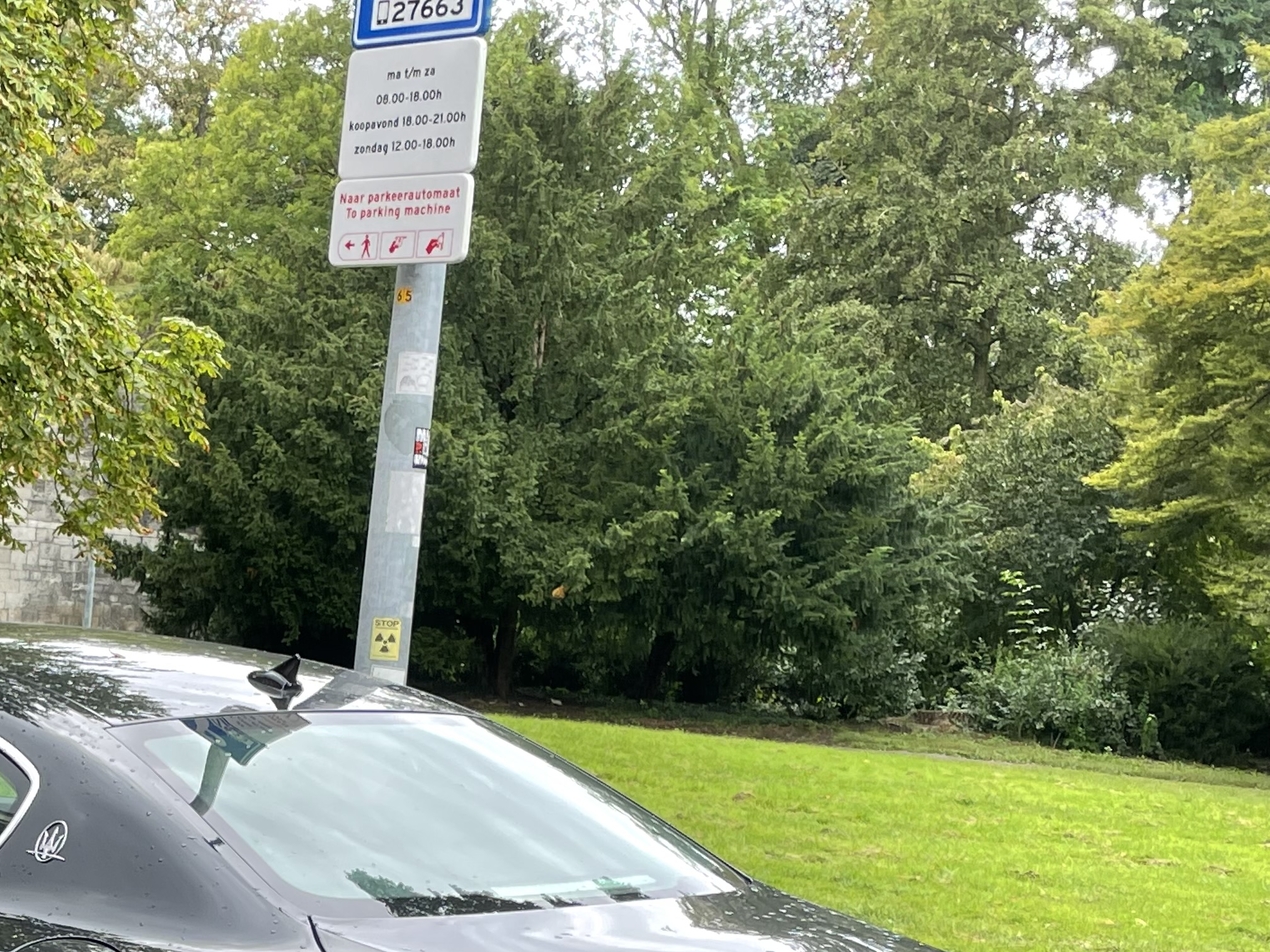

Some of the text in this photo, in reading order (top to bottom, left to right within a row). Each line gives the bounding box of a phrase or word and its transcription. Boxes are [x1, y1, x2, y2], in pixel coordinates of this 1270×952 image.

[391, 0, 463, 23] 27663
[387, 67, 436, 80] ma t/m za
[376, 89, 442, 105] 08.00-18.00h
[349, 111, 467, 132] koopavond 18.00-21.00h
[354, 137, 456, 155] zondag 12.00-18.00h
[339, 186, 461, 205] Naar parkeerautomaat
[346, 203, 451, 220] To parking machine
[396, 289, 413, 303] 65
[375, 619, 400, 627] STOP
